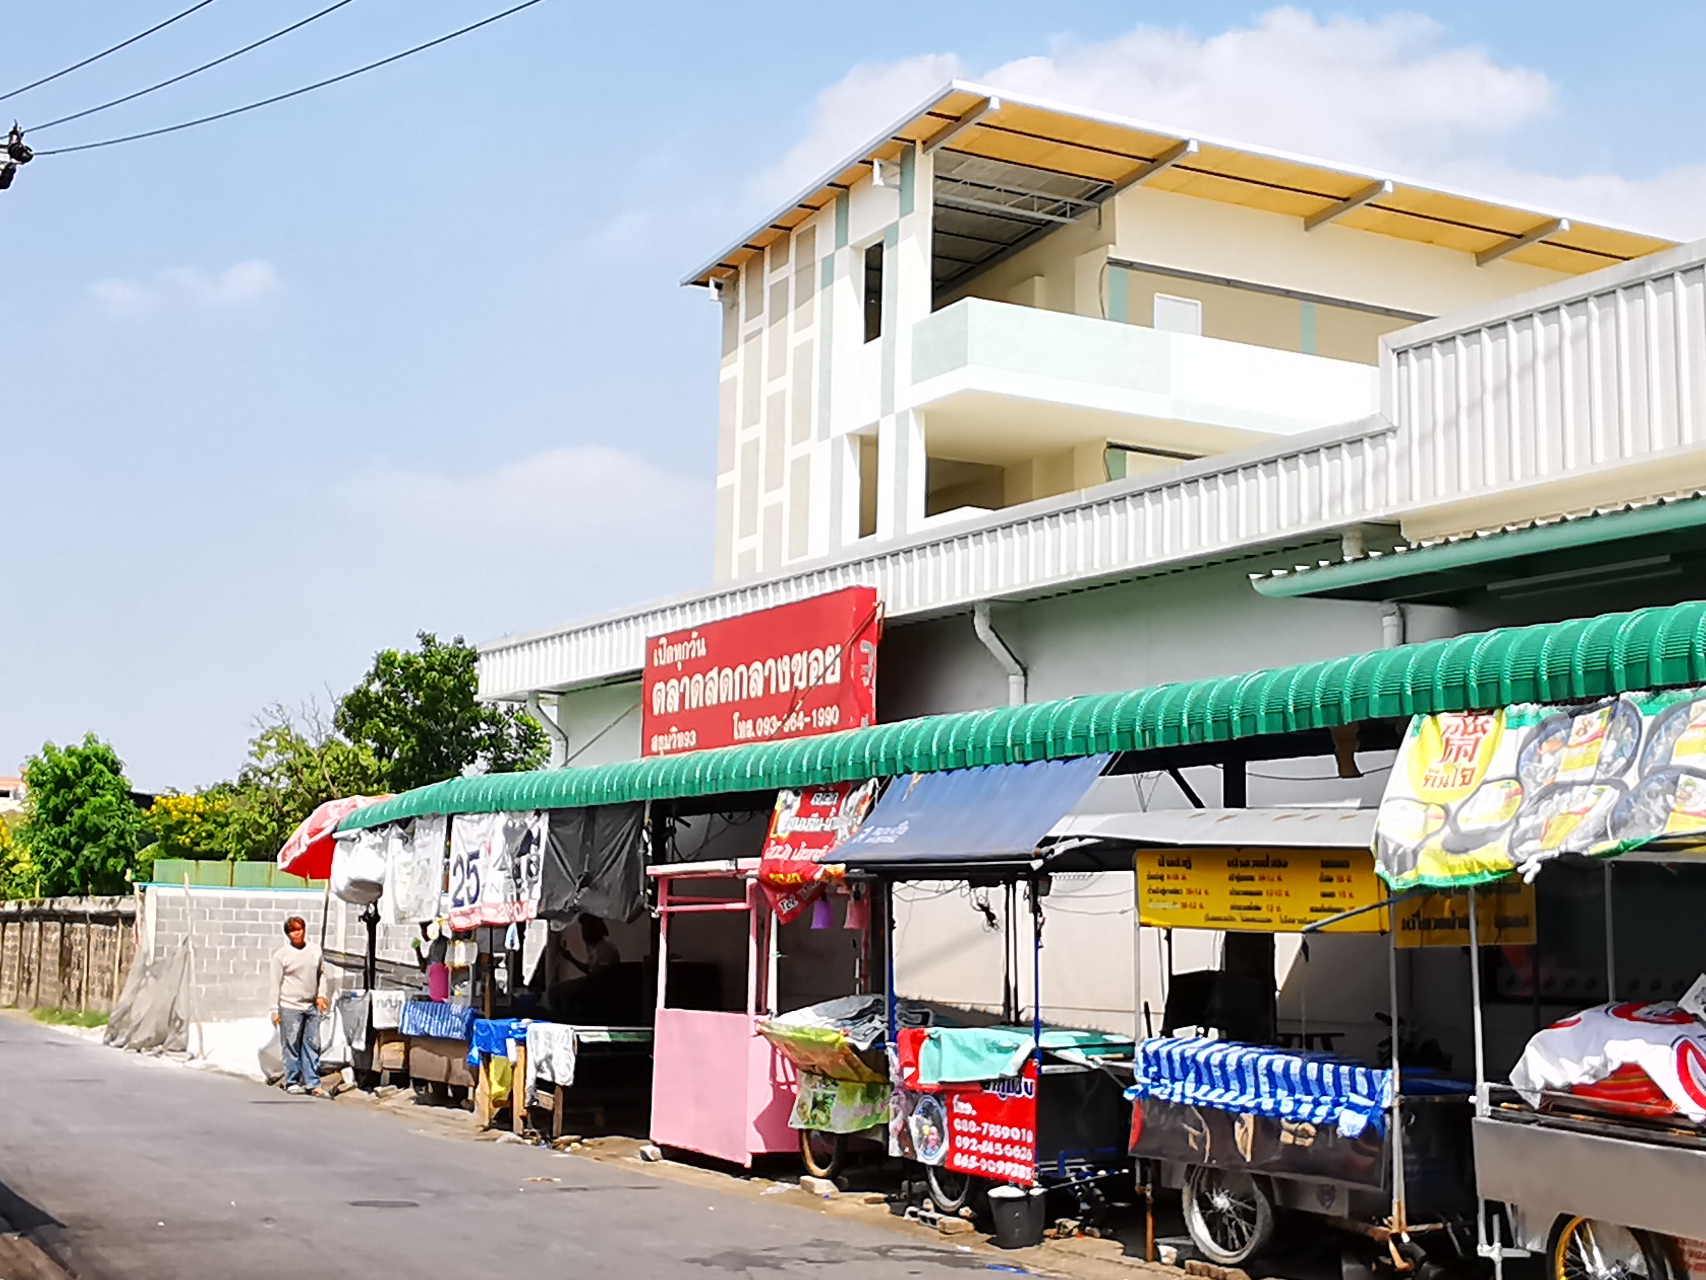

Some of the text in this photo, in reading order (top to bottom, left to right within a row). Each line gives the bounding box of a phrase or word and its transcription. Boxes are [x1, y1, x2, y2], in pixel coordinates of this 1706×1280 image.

[652, 644, 841, 716] ตลาดสดกลางซอย
